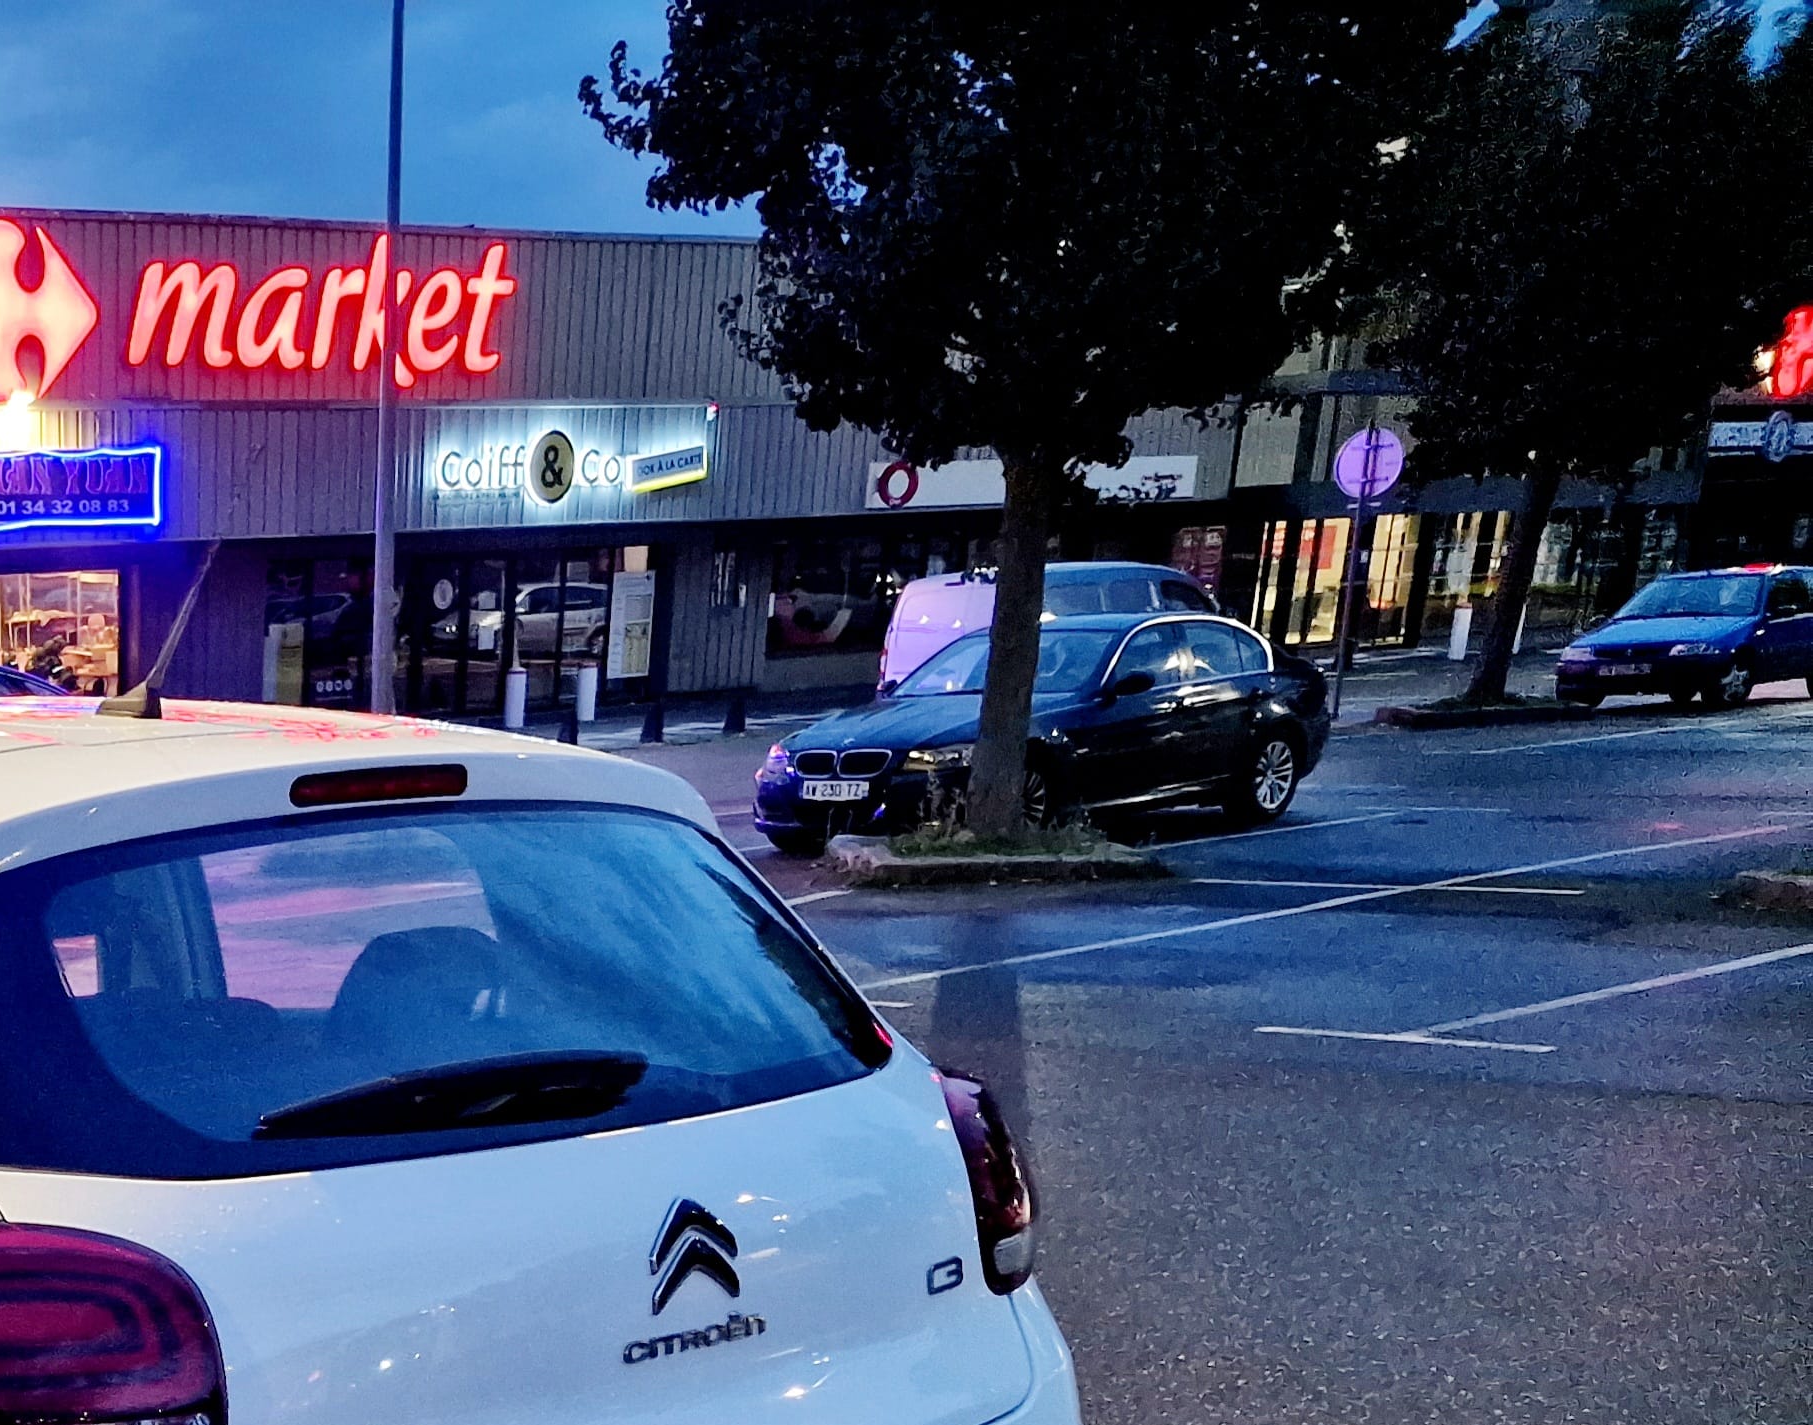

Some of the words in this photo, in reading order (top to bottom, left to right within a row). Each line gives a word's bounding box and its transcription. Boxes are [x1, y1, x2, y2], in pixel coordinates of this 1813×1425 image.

[127, 231, 517, 389] market
[60, 456, 150, 496] YUAN
[439, 445, 526, 488] Coiff
[541, 444, 564, 488] &
[581, 449, 621, 485] Co
[21, 500, 45, 515] 34
[51, 499, 74, 515] 32
[79, 499, 101, 514] 08
[107, 498, 130, 513] 83
